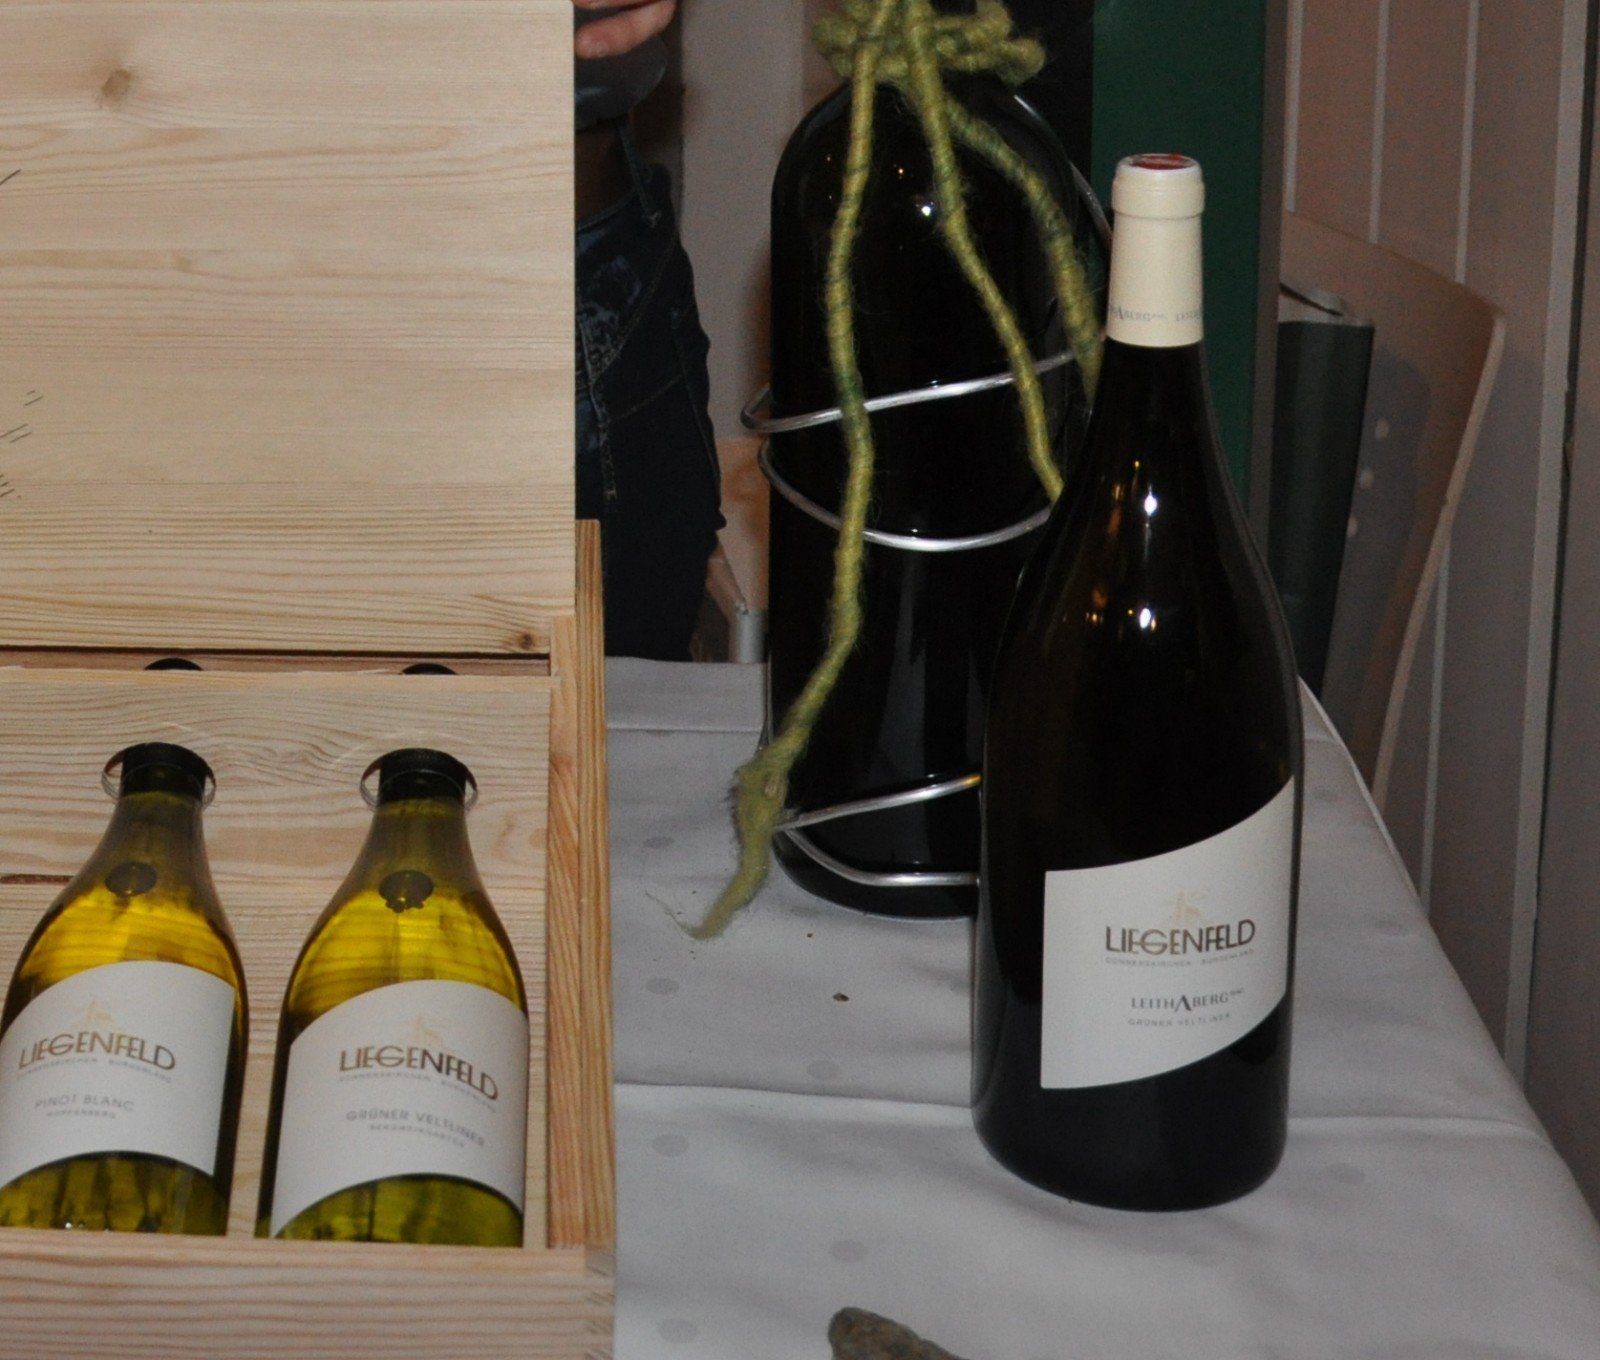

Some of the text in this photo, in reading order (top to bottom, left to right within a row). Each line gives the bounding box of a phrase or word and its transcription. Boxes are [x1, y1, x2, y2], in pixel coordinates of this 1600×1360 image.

[1105, 918, 1256, 956] LIEGENFELD
[1130, 992, 1229, 1013] LEITHABERG
[18, 1030, 176, 1071] LIEGENFELD
[339, 1045, 499, 1101] LIEGENFELD
[34, 1093, 135, 1112] PINOT BLANC
[345, 1107, 410, 1122] GRÜNER
